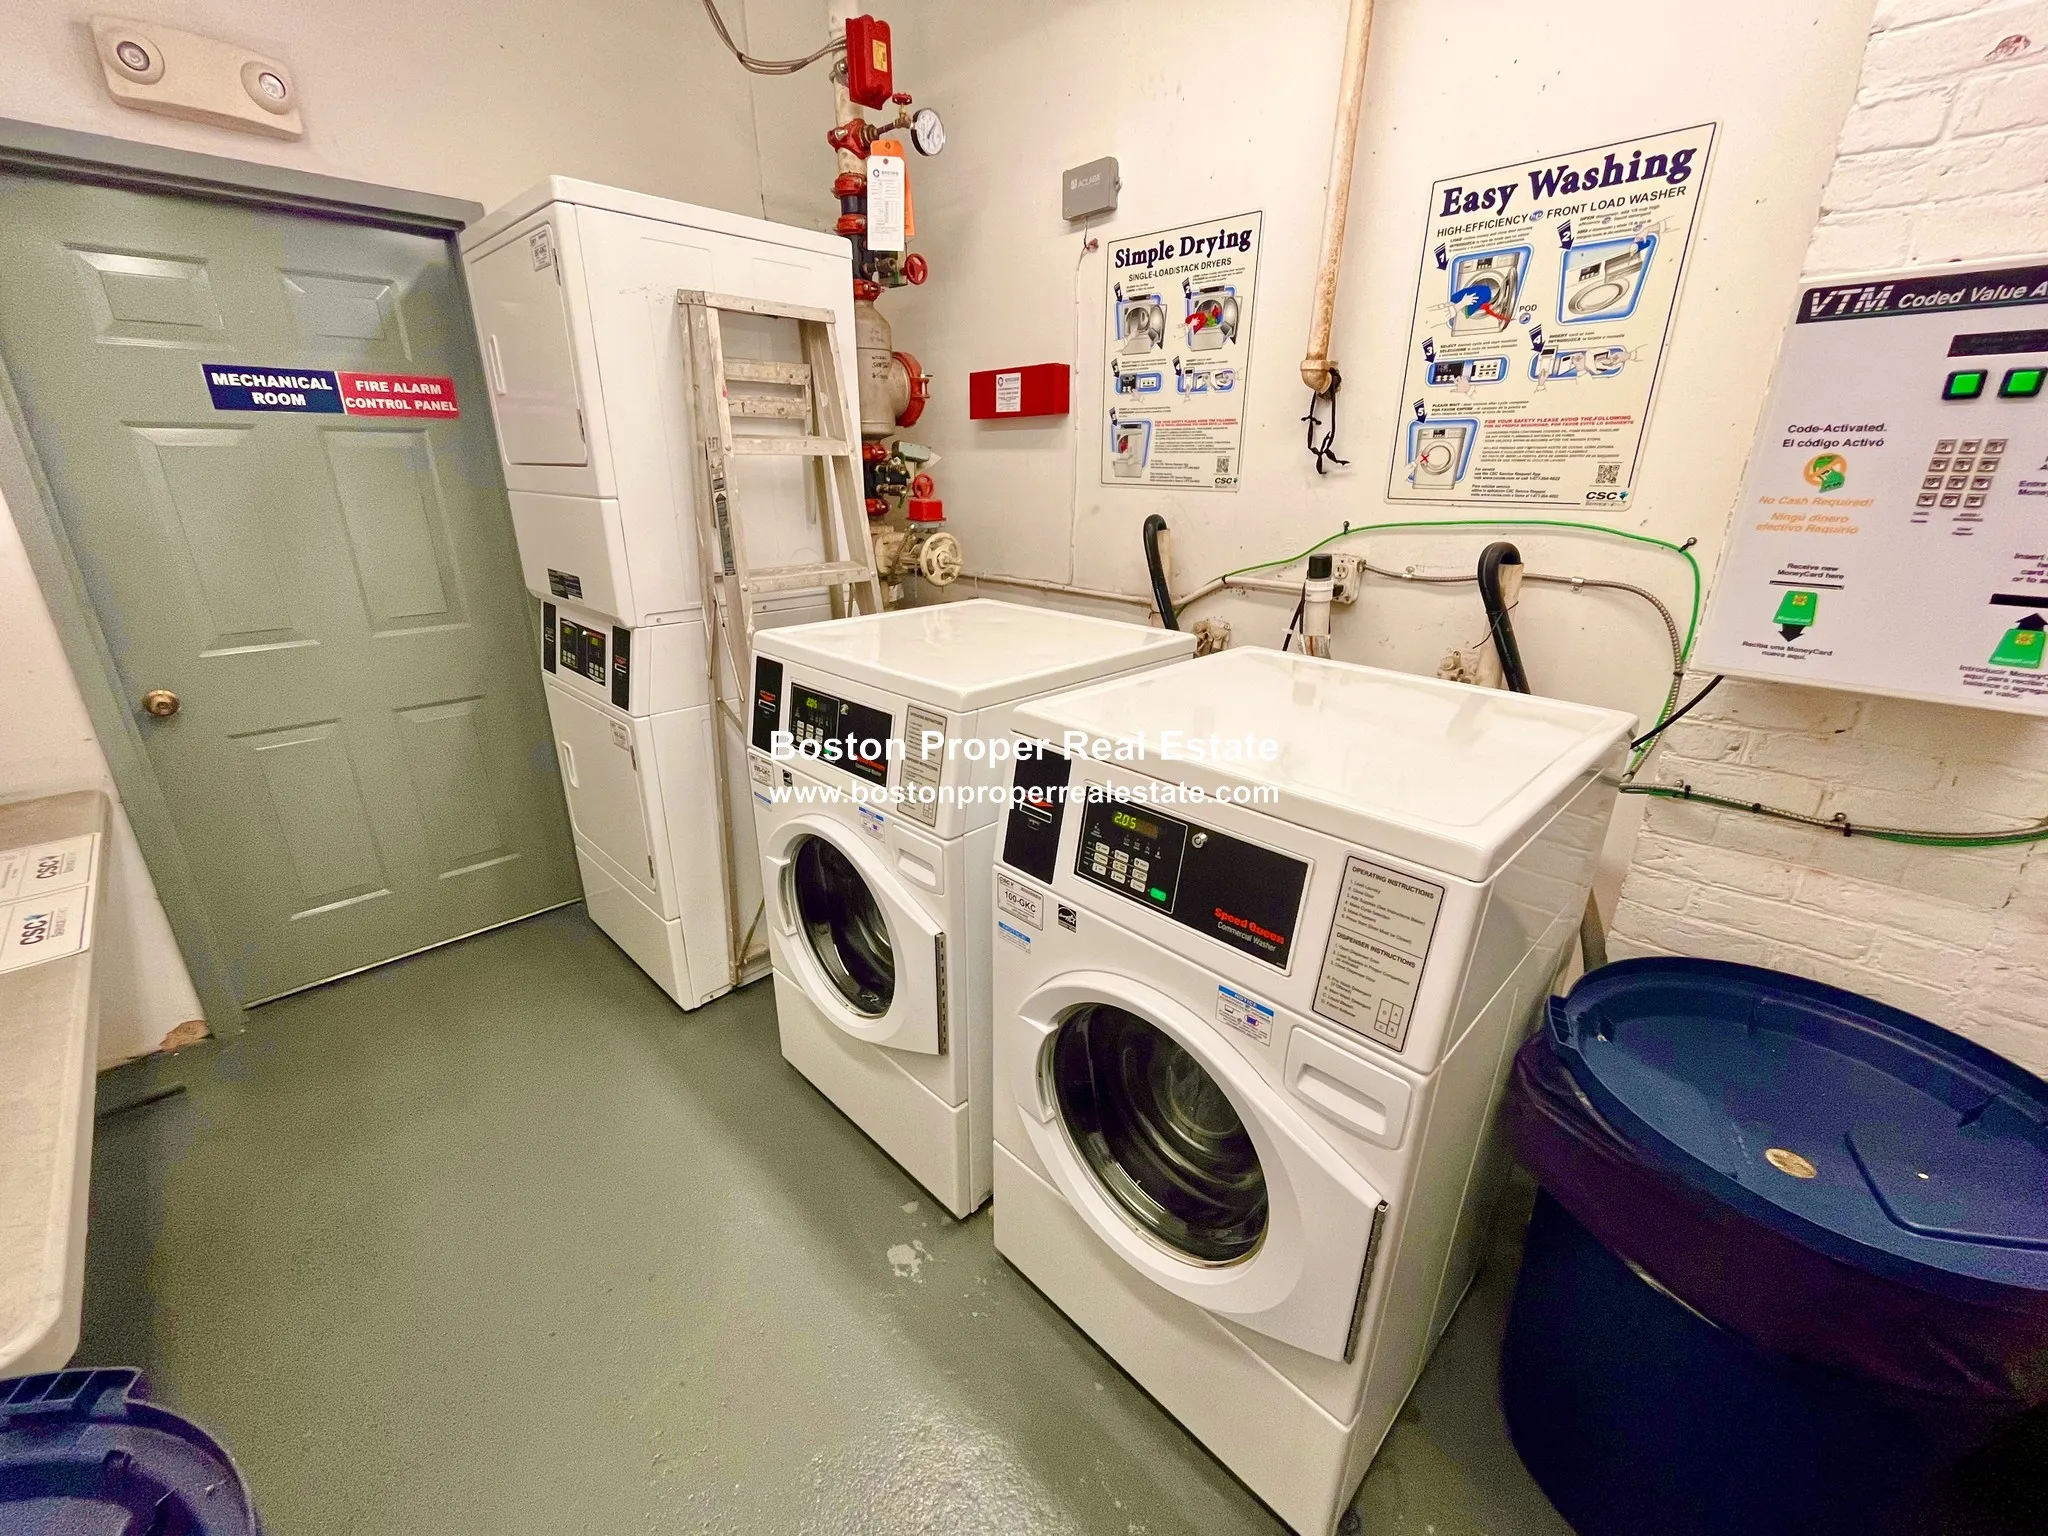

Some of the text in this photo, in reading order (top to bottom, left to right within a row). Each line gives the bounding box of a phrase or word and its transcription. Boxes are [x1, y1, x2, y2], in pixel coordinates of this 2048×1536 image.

[1439, 147, 1697, 217] Easy Washing
[1437, 186, 1687, 237] HIGH-EFFICIENCY FRONT LOAD WASHER
[1562, 232, 1570, 241] 2
[1115, 229, 1253, 268] Simple Drying
[1128, 264, 1199, 282] SINGLE-LOAD/STACK
[1201, 258, 1232, 270] DRYERS
[1810, 284, 2048, 317] VTM Coded Value A
[1519, 304, 1538, 312] POD
[1534, 335, 1541, 344] 4
[1426, 347, 1432, 355] 3
[211, 373, 333, 391] MECHANICAL
[355, 381, 442, 395] FIRE ALARM
[252, 392, 306, 406] ROOM
[415, 400, 457, 412] PANEL
[1418, 408, 1424, 416] 5
[1787, 423, 1888, 434] Code-Activated.
[1782, 437, 1885, 450] El código Activó
[1586, 491, 1617, 500] CSC
[1758, 496, 1775, 504] No
[1811, 497, 1875, 507] Required!
[1809, 514, 1849, 523] dinero
[1756, 523, 1803, 532] efectivo
[1777, 569, 1824, 580] MoneyCard
[1786, 563, 1819, 572] Receive
[1742, 641, 1768, 649] Reciba
[1787, 646, 1833, 656] MoneyCard
[1959, 665, 2007, 674] Introducir
[1114, 812, 1137, 829] 2.05
[37, 860, 60, 879] CSC
[1352, 866, 1434, 899] OPERATING INSTRUCTIONS
[1005, 891, 1036, 913] 100-GKC
[20, 920, 48, 945] CSC
[1215, 908, 1285, 944] Speed Queen
[1218, 921, 1276, 951] Commercial Washer
[1337, 932, 1415, 968] DISPENSER INSTRUCTIONS
